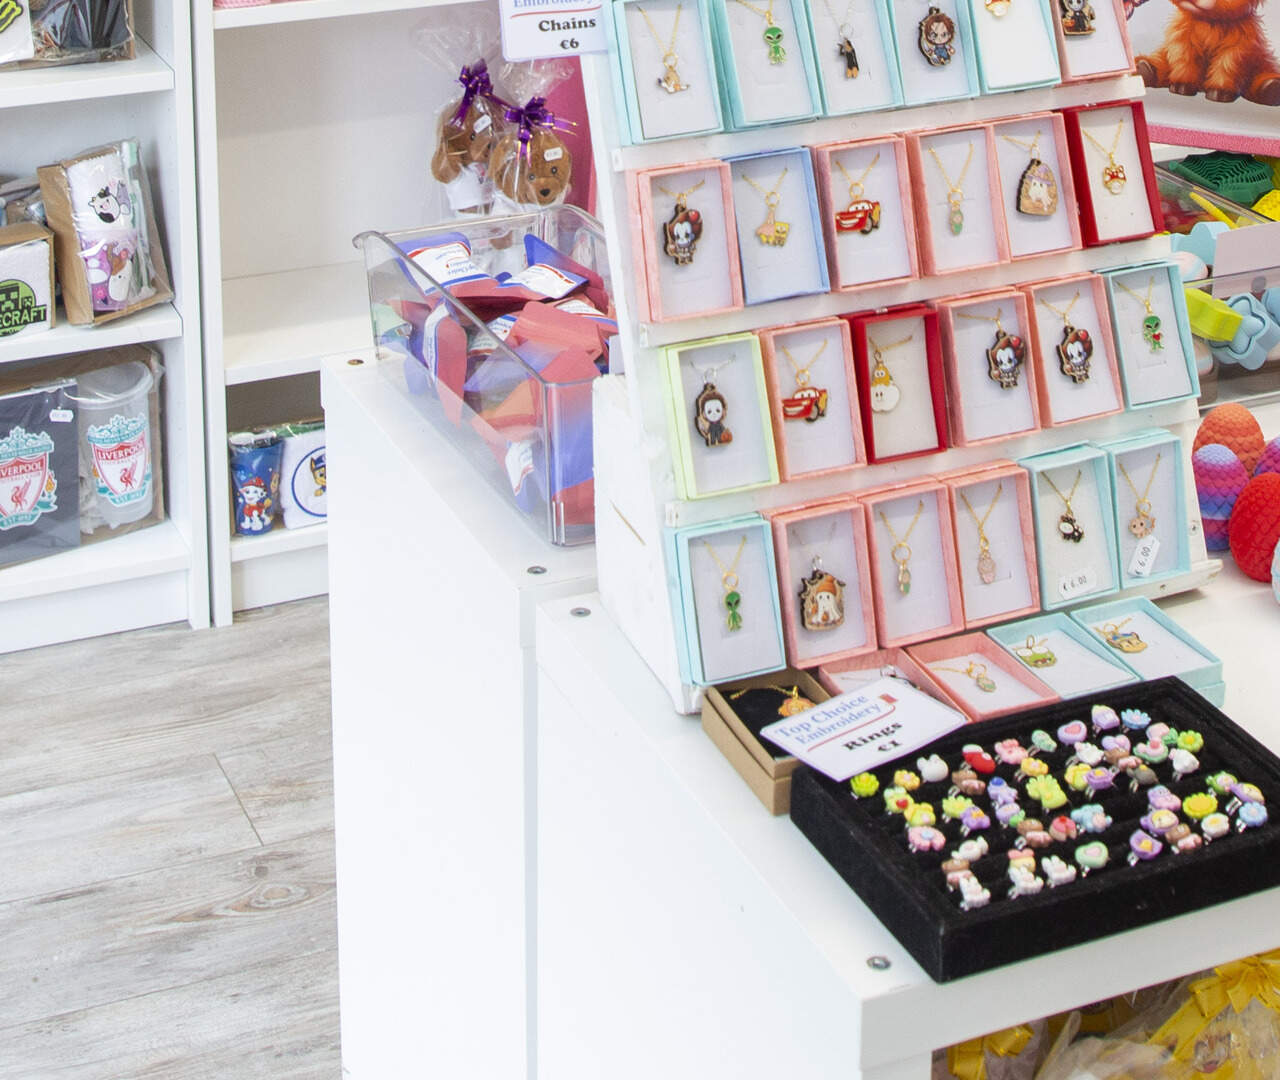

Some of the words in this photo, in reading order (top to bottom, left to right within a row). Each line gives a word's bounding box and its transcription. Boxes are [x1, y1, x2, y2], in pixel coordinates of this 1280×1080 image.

[538, 17, 597, 32] Chains
[560, 38, 580, 50] €6
[98, 438, 146, 461] LIVERPOOL
[776, 720, 812, 738] Top
[811, 695, 870, 722] Choice
[795, 703, 882, 745] Embroidery
[842, 722, 903, 751] Rings
[877, 739, 902, 752] €1
